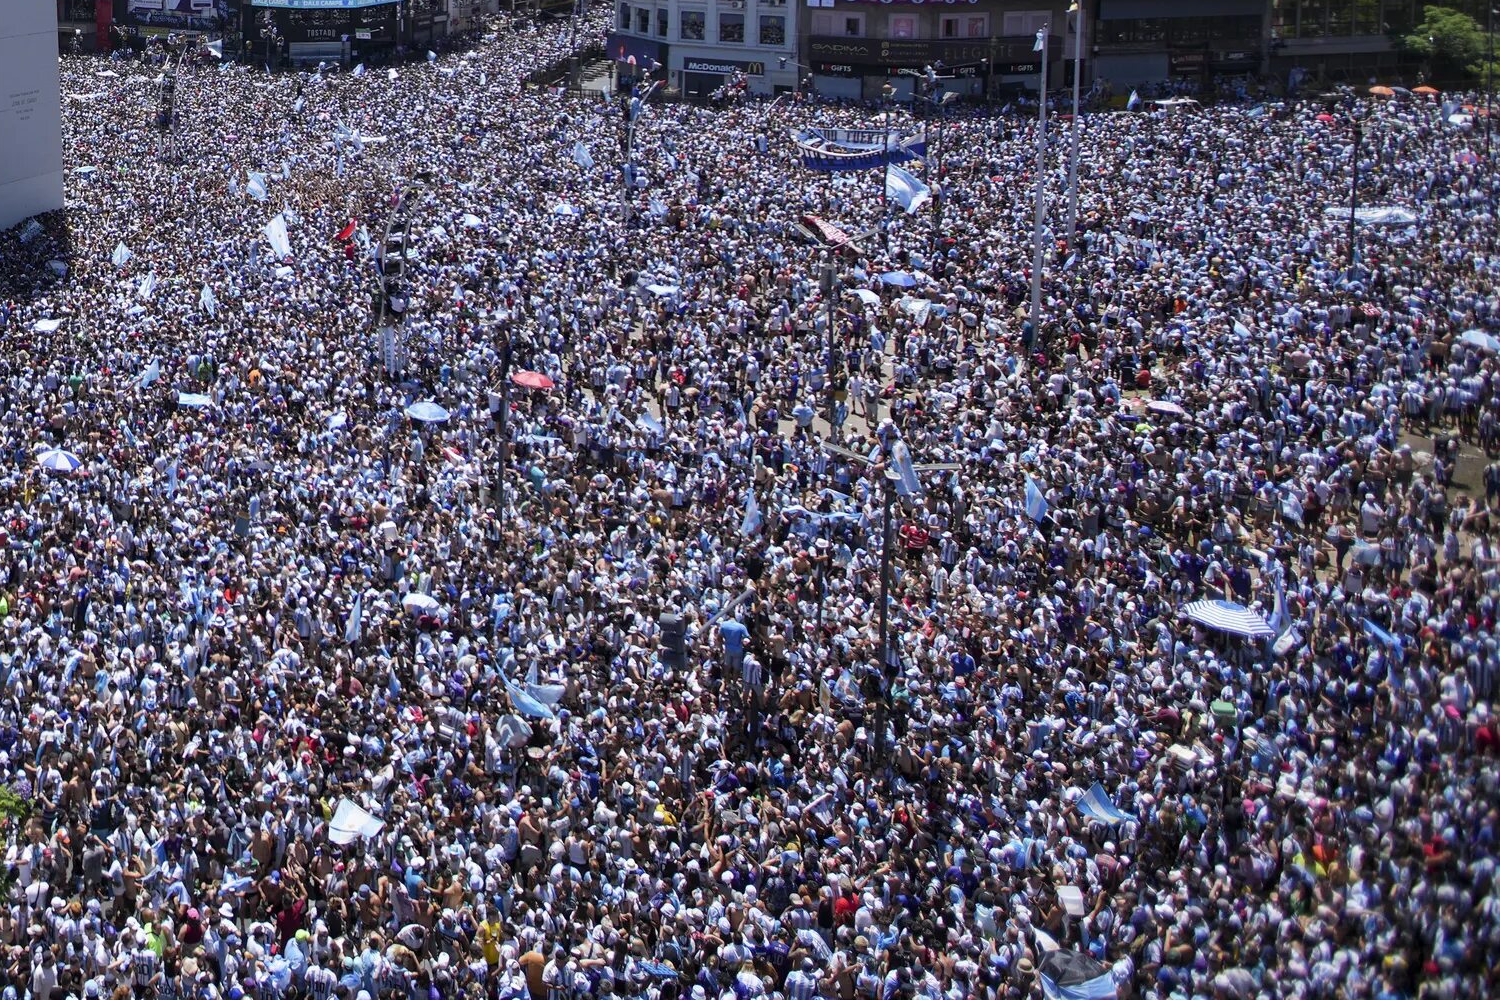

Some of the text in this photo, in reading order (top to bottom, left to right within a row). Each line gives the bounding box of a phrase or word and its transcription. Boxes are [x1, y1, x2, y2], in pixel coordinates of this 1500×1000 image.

[307, 29, 336, 37] TOSTADO
[688, 63, 741, 72] McDonald
[315, 981, 325, 993] 10
